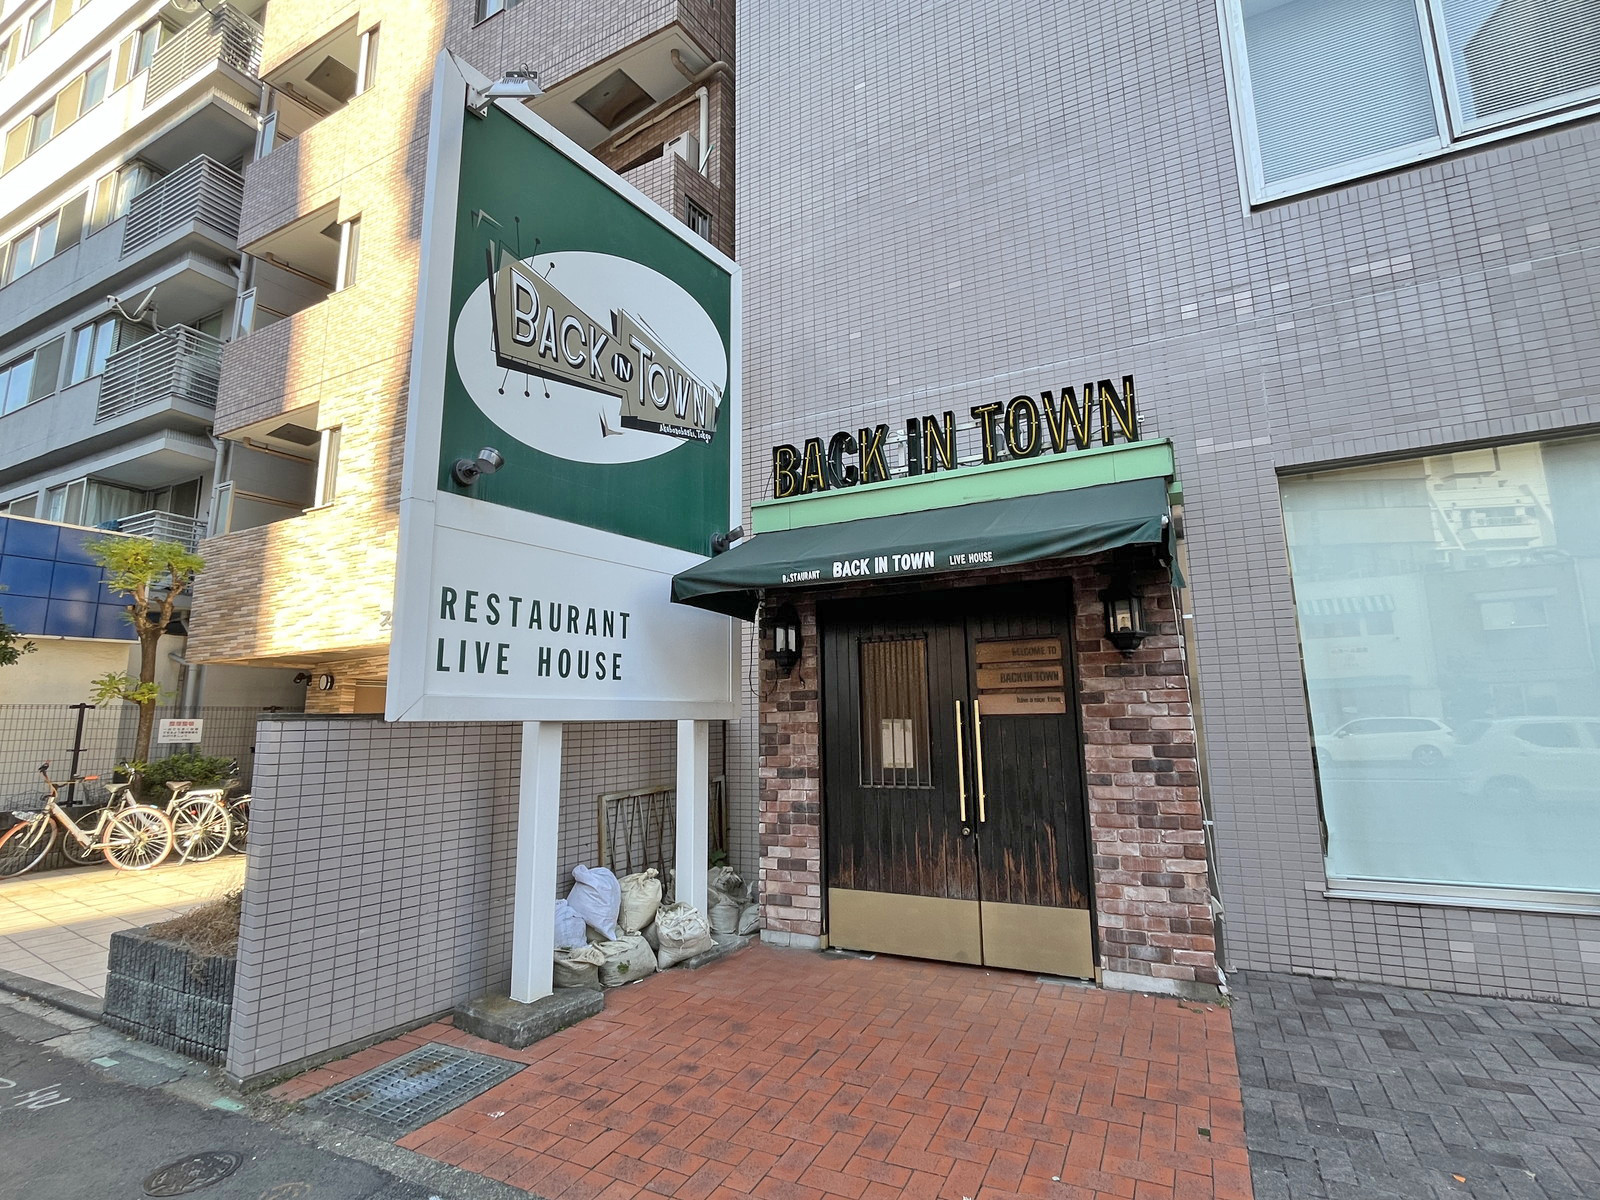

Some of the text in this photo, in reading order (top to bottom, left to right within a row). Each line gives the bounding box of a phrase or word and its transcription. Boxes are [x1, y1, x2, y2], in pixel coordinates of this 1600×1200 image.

[510, 267, 710, 428] BACK IN TOWN
[773, 374, 1139, 499] BACK IN TOWN
[832, 558, 870, 578] BACK
[874, 555, 888, 574] IN
[892, 551, 935, 572] TOWN
[949, 554, 966, 566] LIVE
[968, 551, 993, 564] HOUSE
[439, 585, 630, 640] RESTAURANT
[436, 637, 623, 681] LIVE HOUSE
[1048, 646, 1057, 655] TO
[1034, 671, 1059, 681] TOWN
